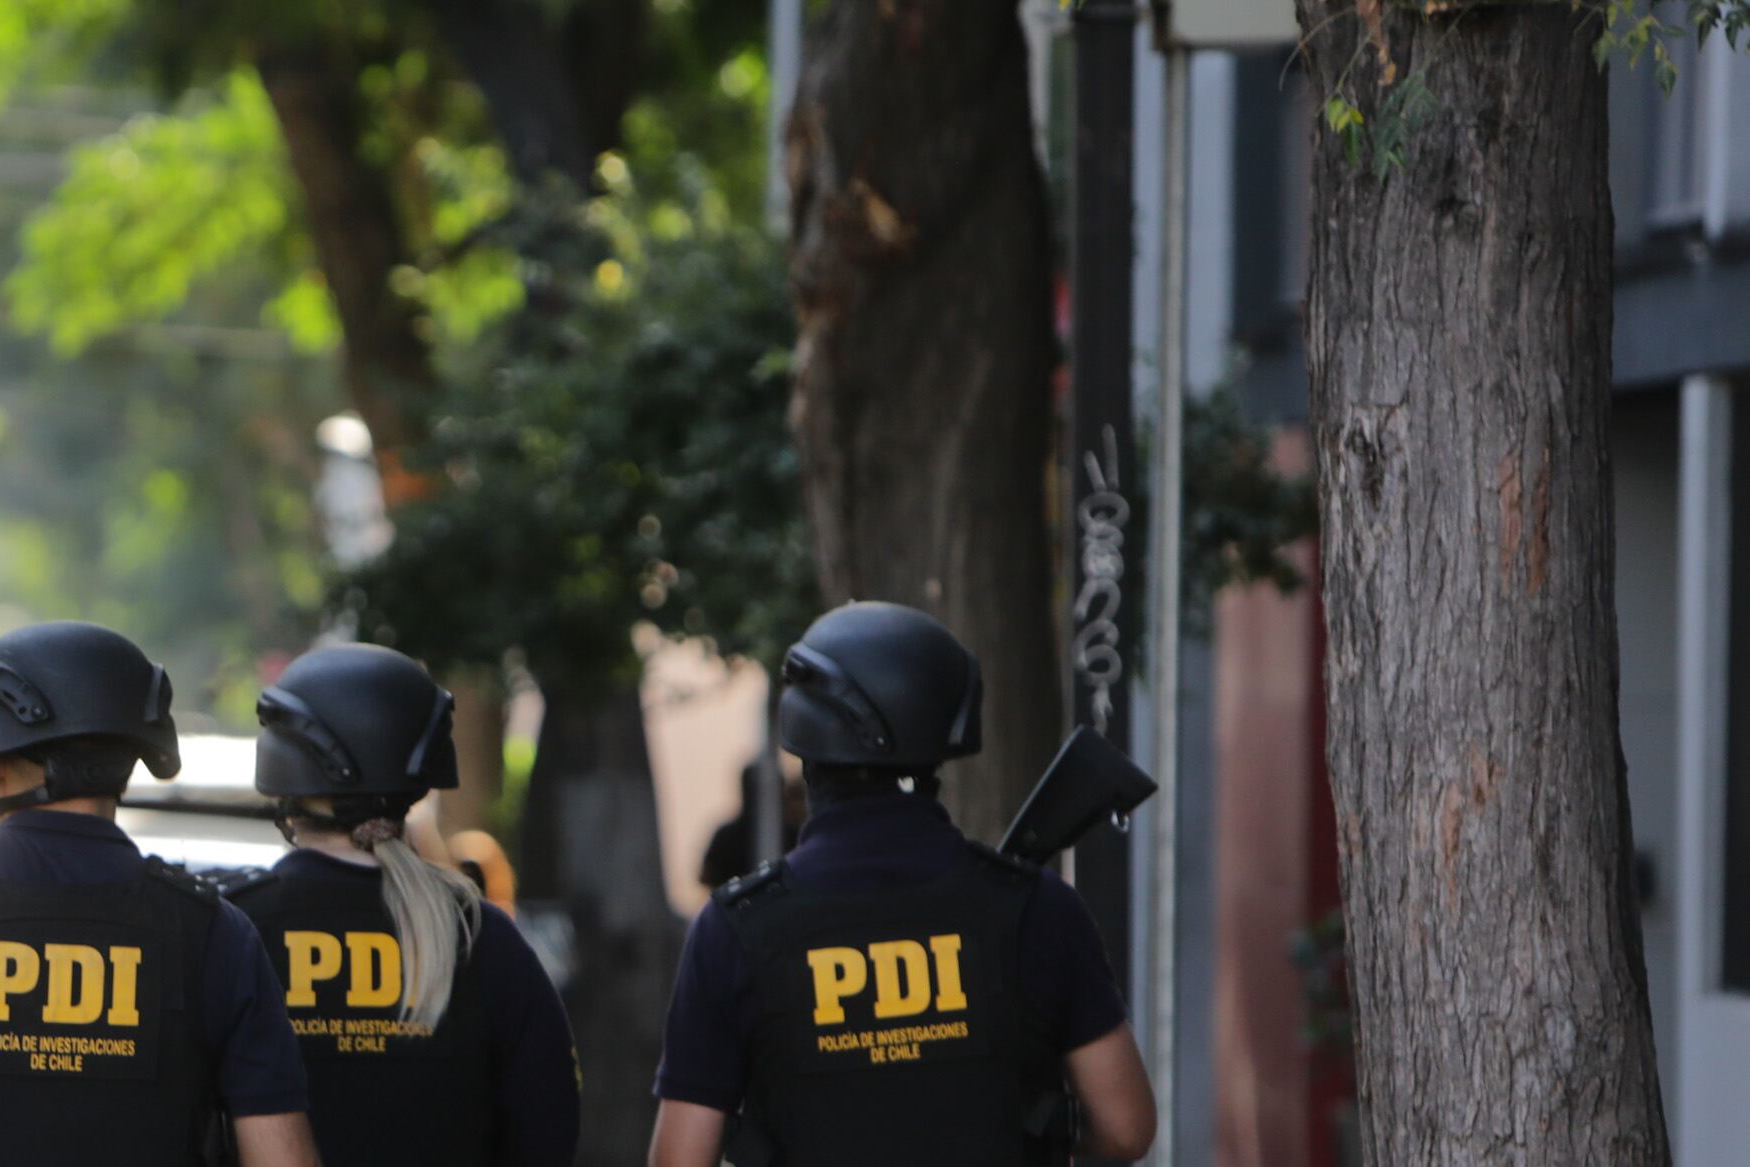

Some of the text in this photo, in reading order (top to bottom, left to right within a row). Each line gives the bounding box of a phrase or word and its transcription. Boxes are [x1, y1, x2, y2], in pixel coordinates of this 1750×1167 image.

[284, 930, 415, 1008] PD
[807, 933, 968, 1026] PDI
[329, 1019, 344, 1035] DE
[817, 1021, 969, 1052] POLICÍA DE INVESTIGACIONES
[22, 1034, 38, 1052] DE
[40, 1035, 135, 1056] INVESTIGACIONES
[338, 1036, 386, 1053] DE CHILE
[870, 1043, 921, 1064] DE CHILE
[30, 1053, 82, 1072] DE CHILE
